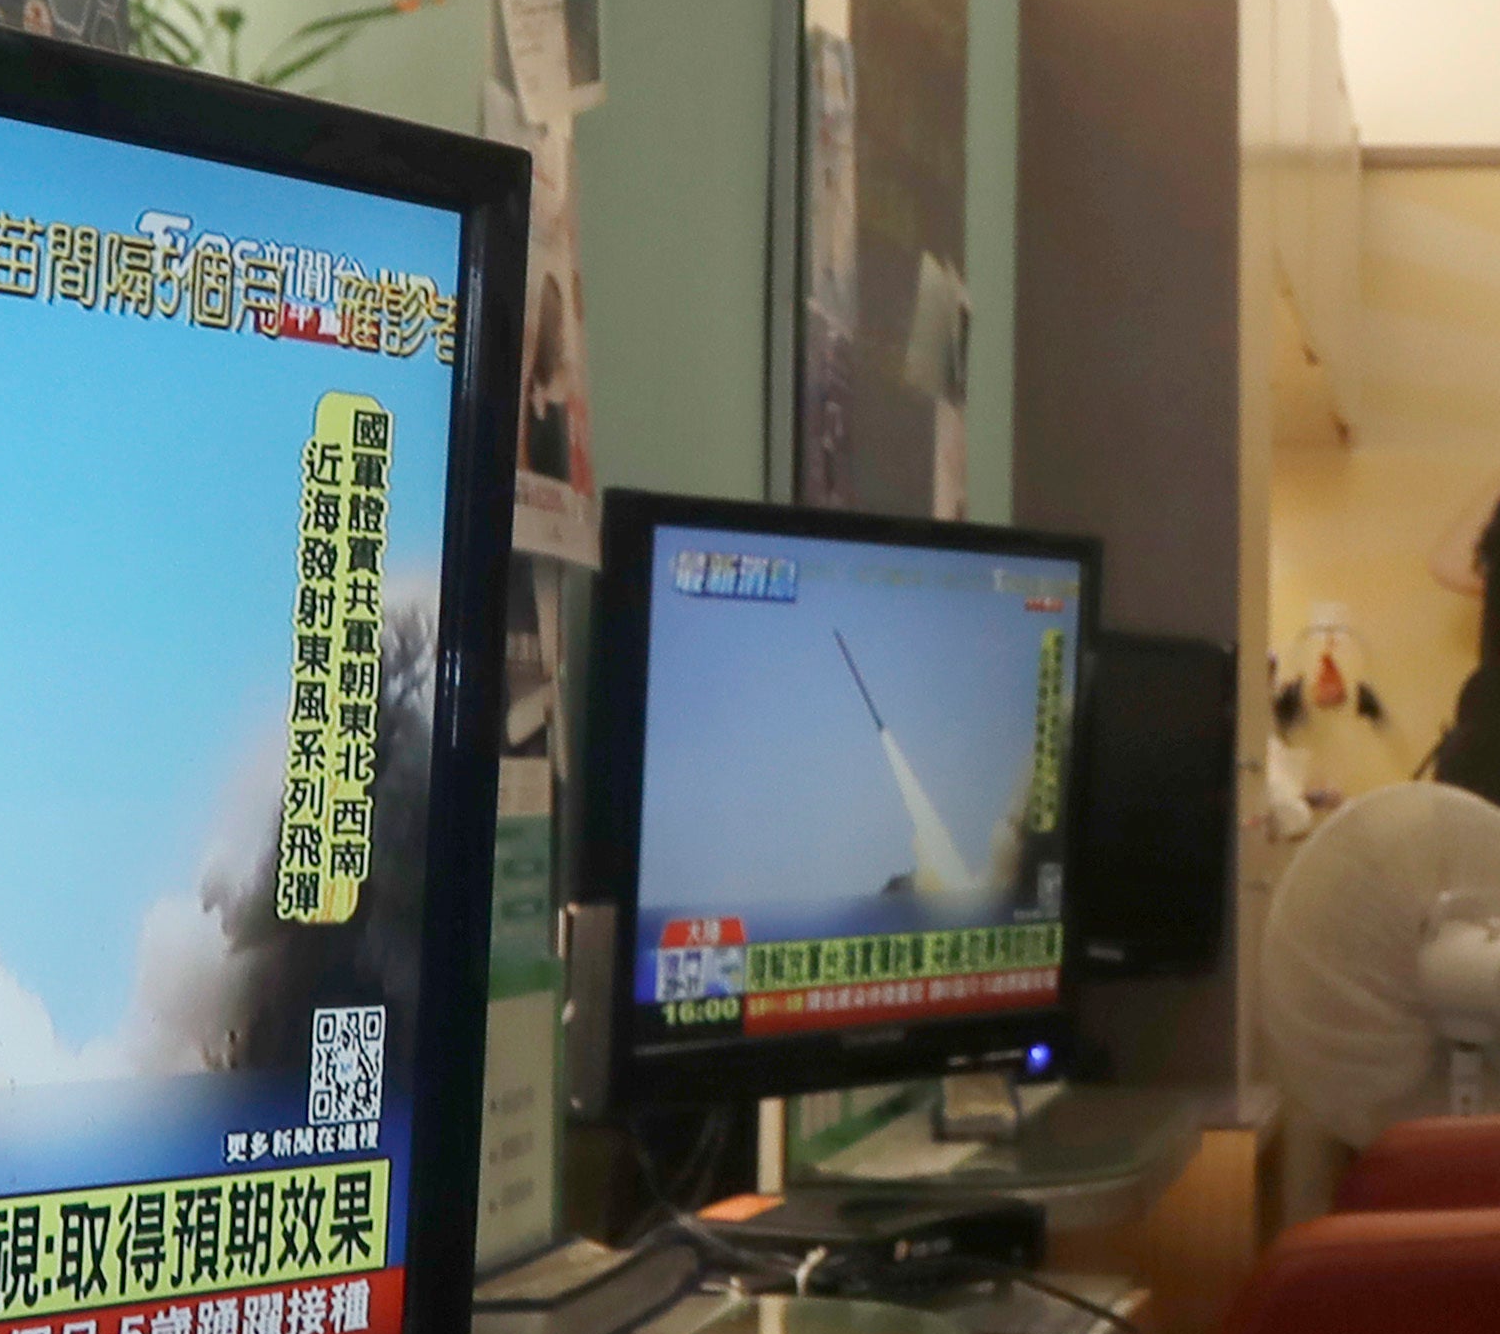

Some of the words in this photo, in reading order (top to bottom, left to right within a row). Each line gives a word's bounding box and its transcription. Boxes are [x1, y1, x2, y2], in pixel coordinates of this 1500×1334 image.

[278, 443, 343, 917] 近海發射東風系列飛彈
[329, 795, 373, 880] 西南
